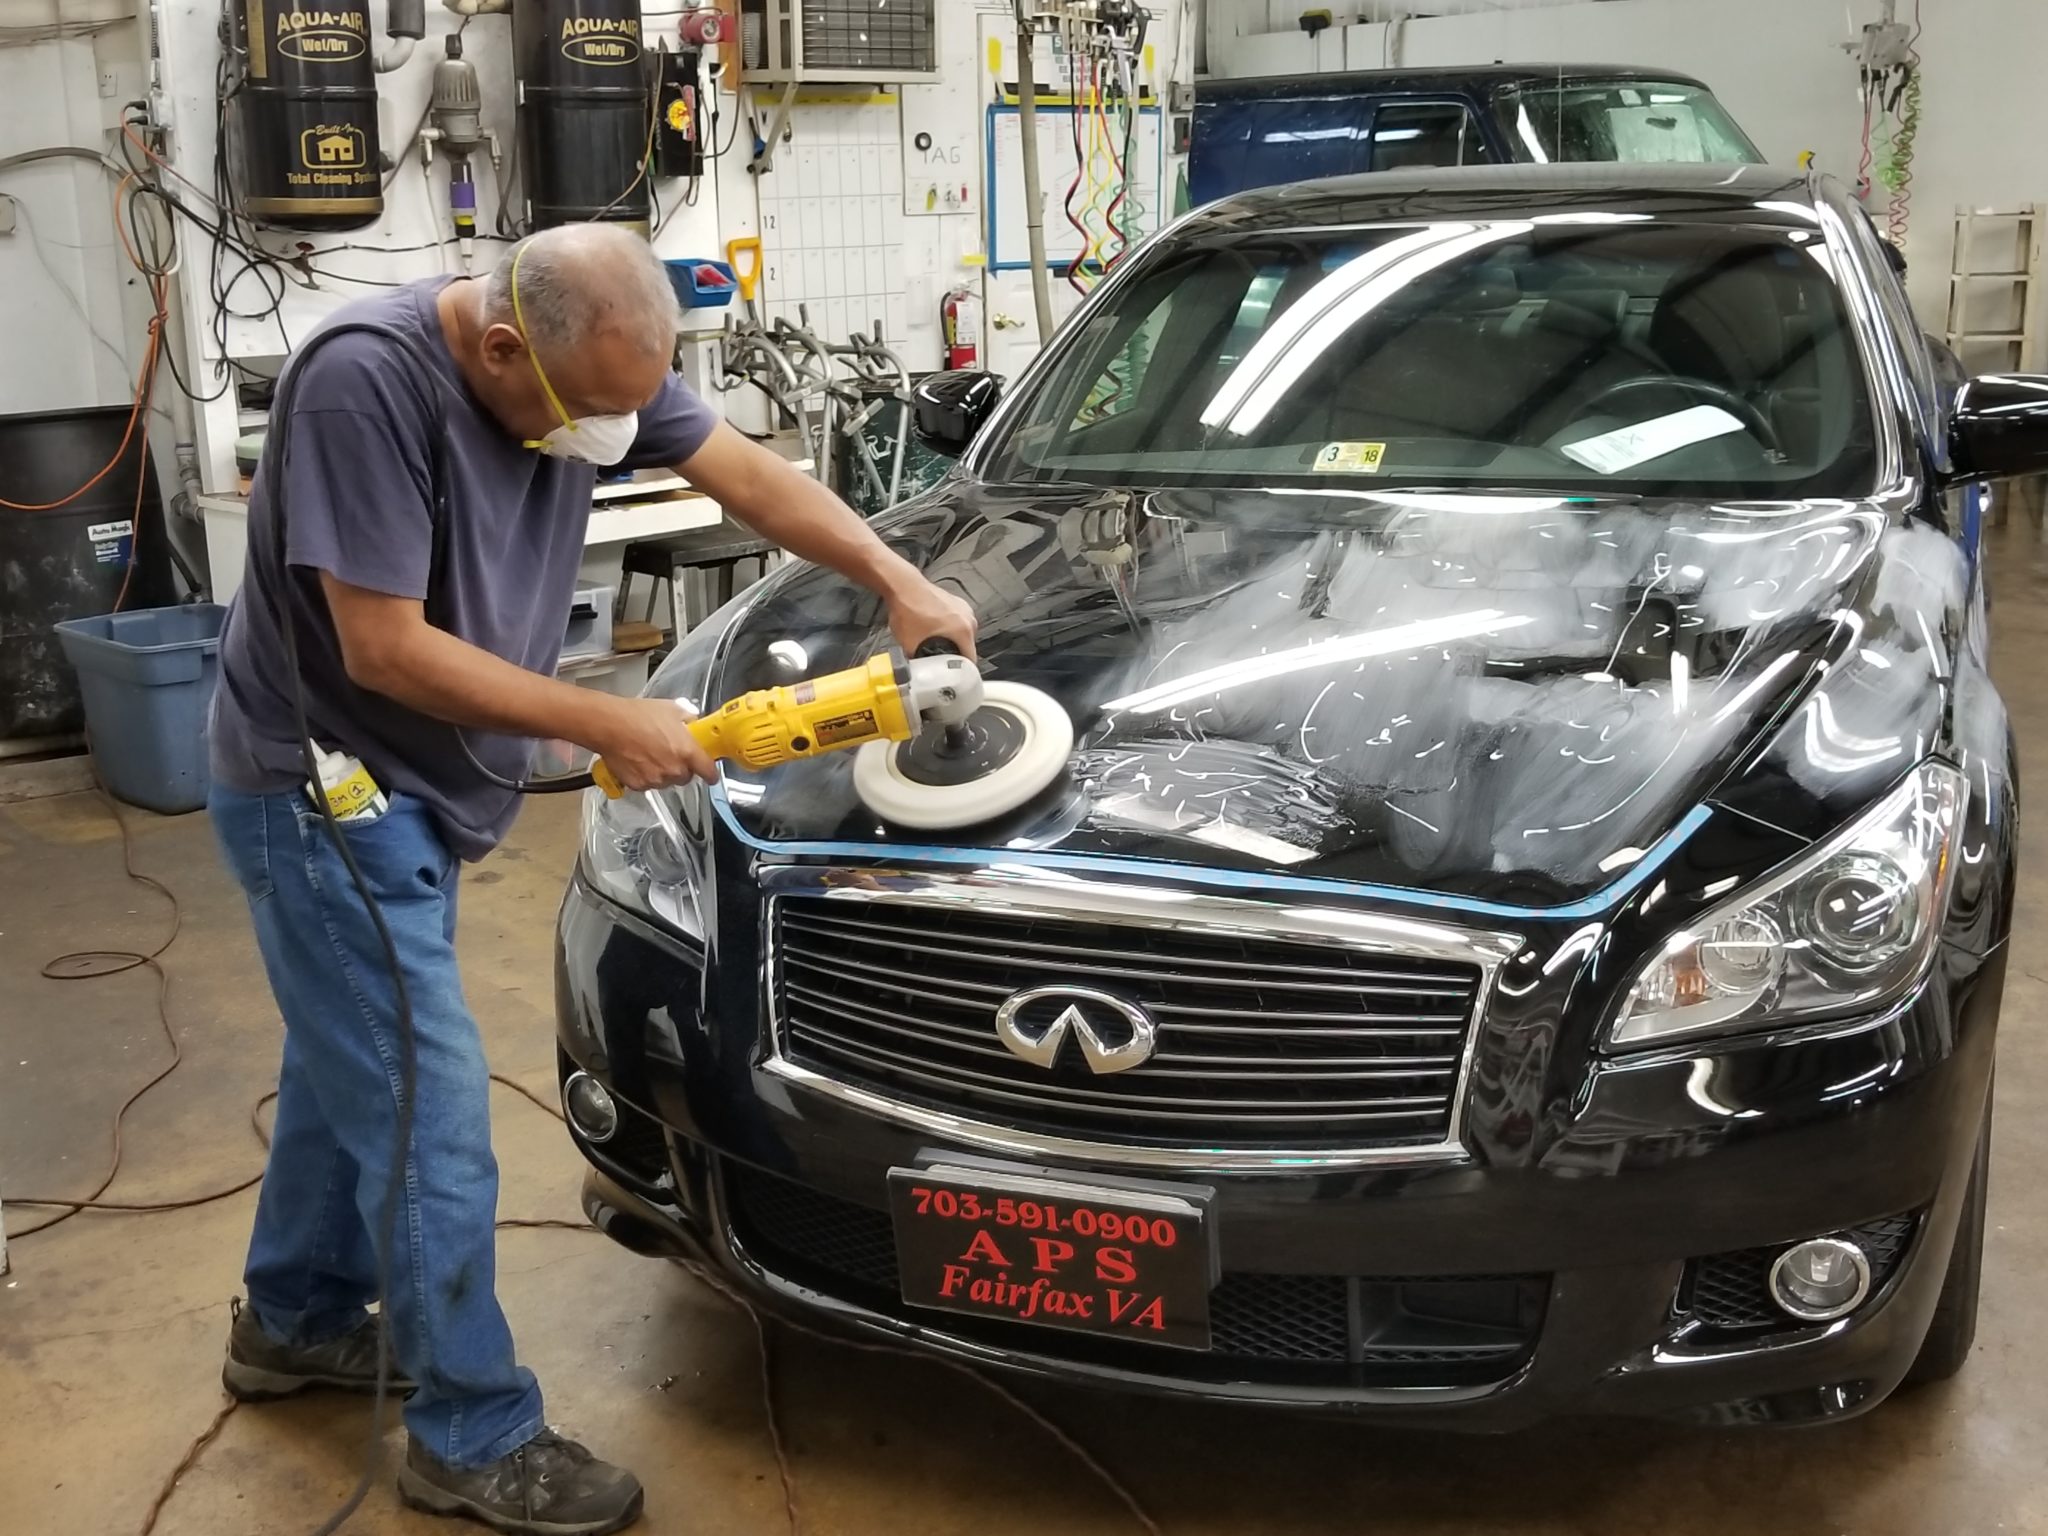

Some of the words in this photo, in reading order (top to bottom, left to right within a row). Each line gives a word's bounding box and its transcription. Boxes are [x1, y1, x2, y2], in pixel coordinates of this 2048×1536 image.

[276, 11, 364, 36] AQUA-AIR
[561, 17, 638, 40] AQUA-AIR
[302, 38, 349, 53] Wet/Dry
[287, 173, 310, 184] Total
[314, 173, 352, 185] Cleaning
[1327, 446, 1340, 462] 3
[1363, 449, 1379, 463] 18
[911, 1187, 1177, 1248] 703-591-0900
[938, 1264, 1094, 1318] Fairfax
[1105, 1288, 1167, 1330] VA
